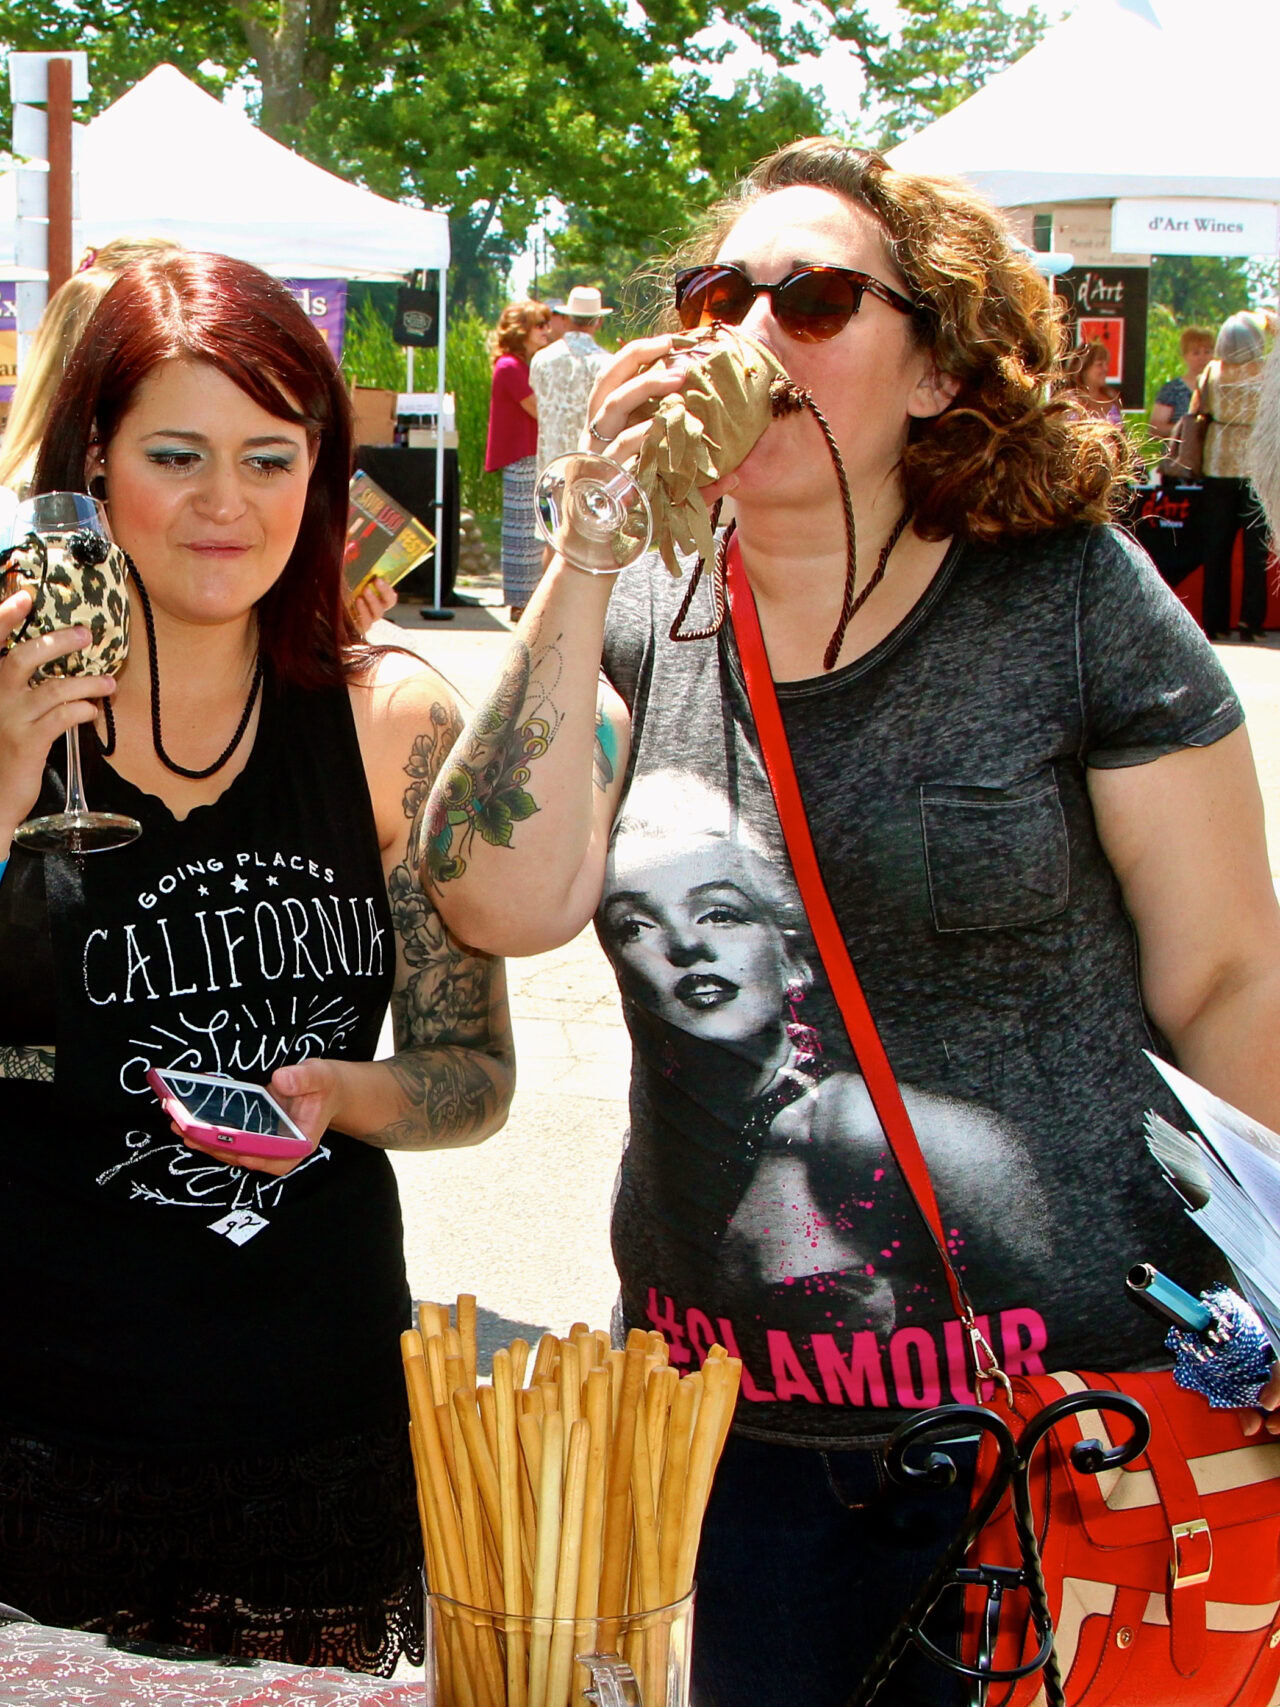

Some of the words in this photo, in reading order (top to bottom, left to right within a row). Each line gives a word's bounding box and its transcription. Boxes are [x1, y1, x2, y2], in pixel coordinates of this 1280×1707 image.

[1148, 216, 1190, 232] d'Art
[1194, 217, 1245, 233] Wines
[1077, 272, 1125, 312] d'Art
[138, 857, 224, 909] GOING
[236, 852, 335, 883] PLACES
[83, 895, 385, 1005] CALIFORNIA
[646, 1287, 1048, 1409] #GLAMOUR
